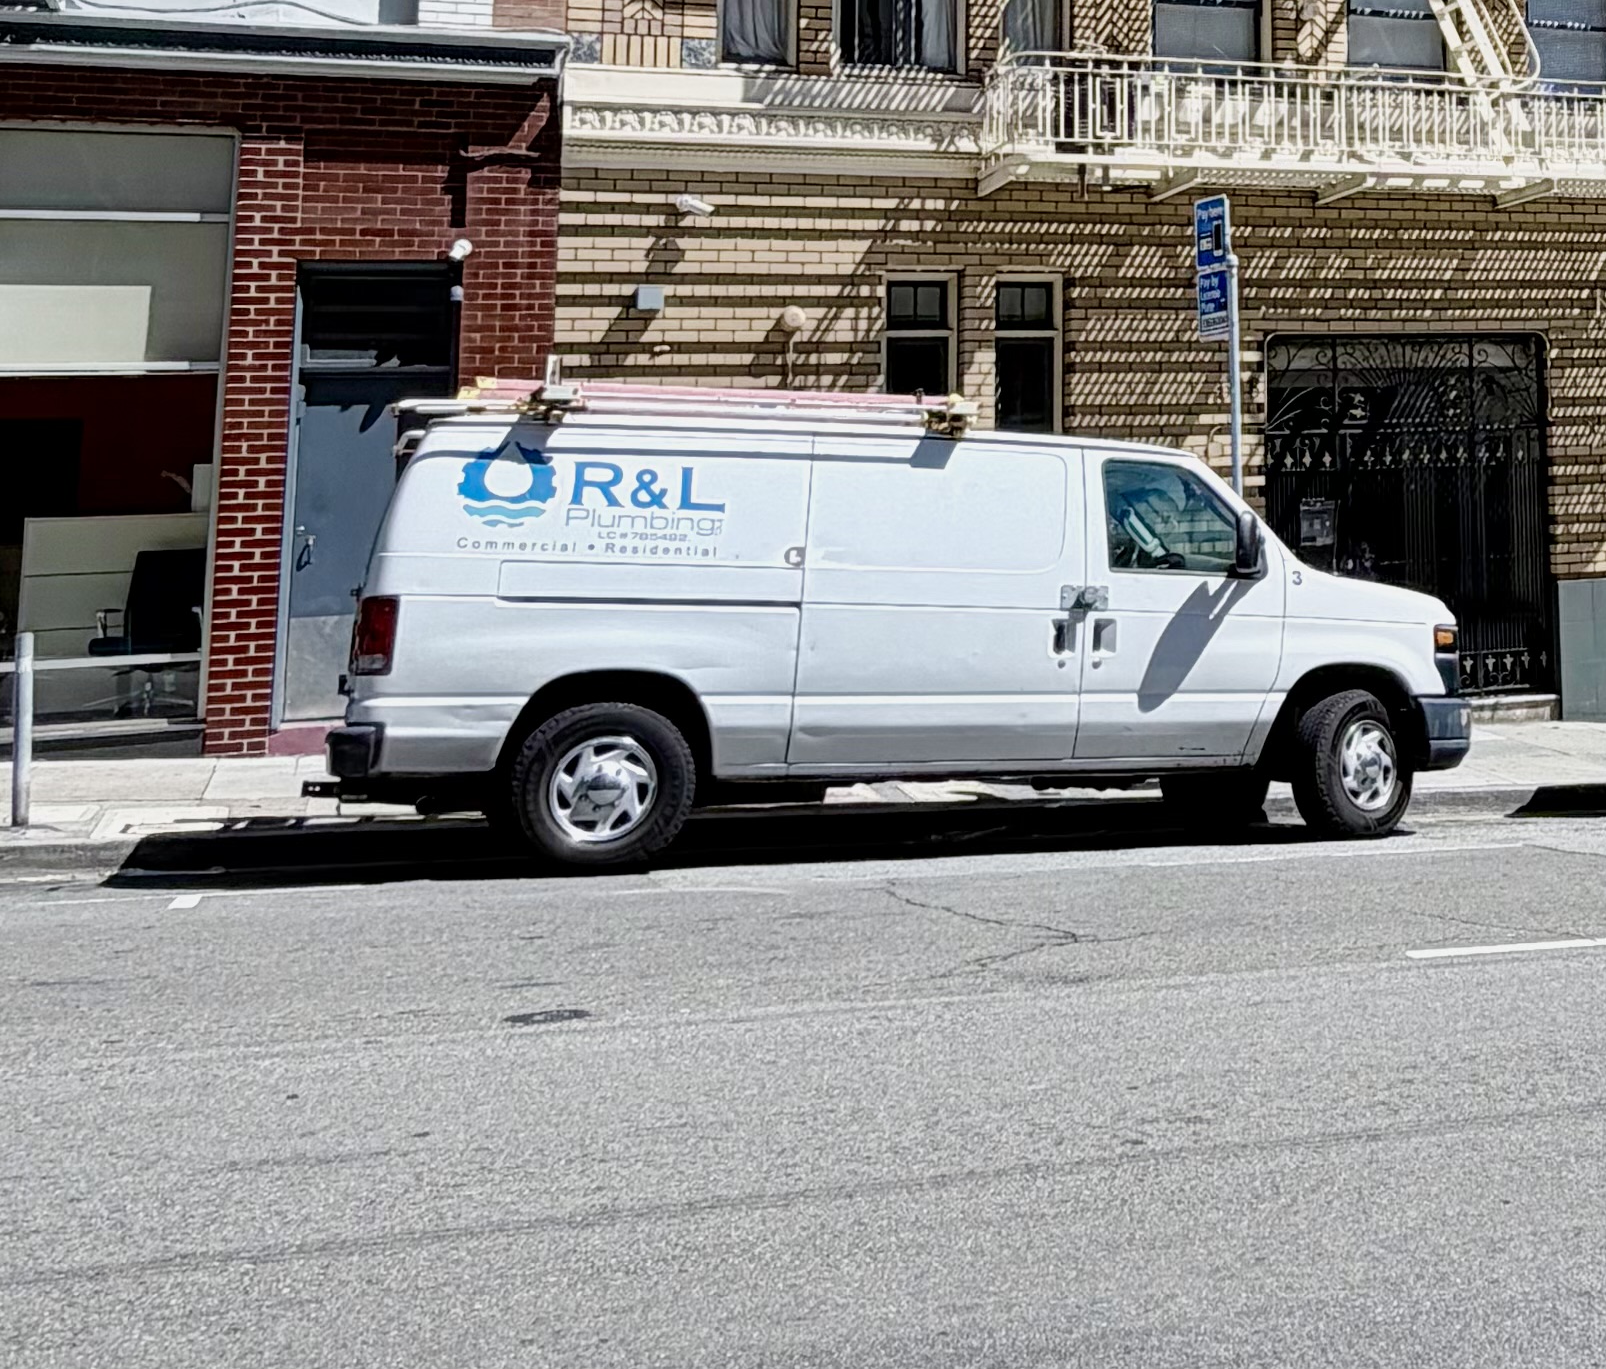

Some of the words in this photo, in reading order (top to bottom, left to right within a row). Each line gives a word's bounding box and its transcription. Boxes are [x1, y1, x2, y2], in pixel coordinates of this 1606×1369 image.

[568, 461, 726, 514] R&L
[564, 507, 716, 537] Plumbing
[456, 536, 577, 553] Commercial
[604, 542, 718, 559] Residential
[1292, 570, 1303, 586] 3
